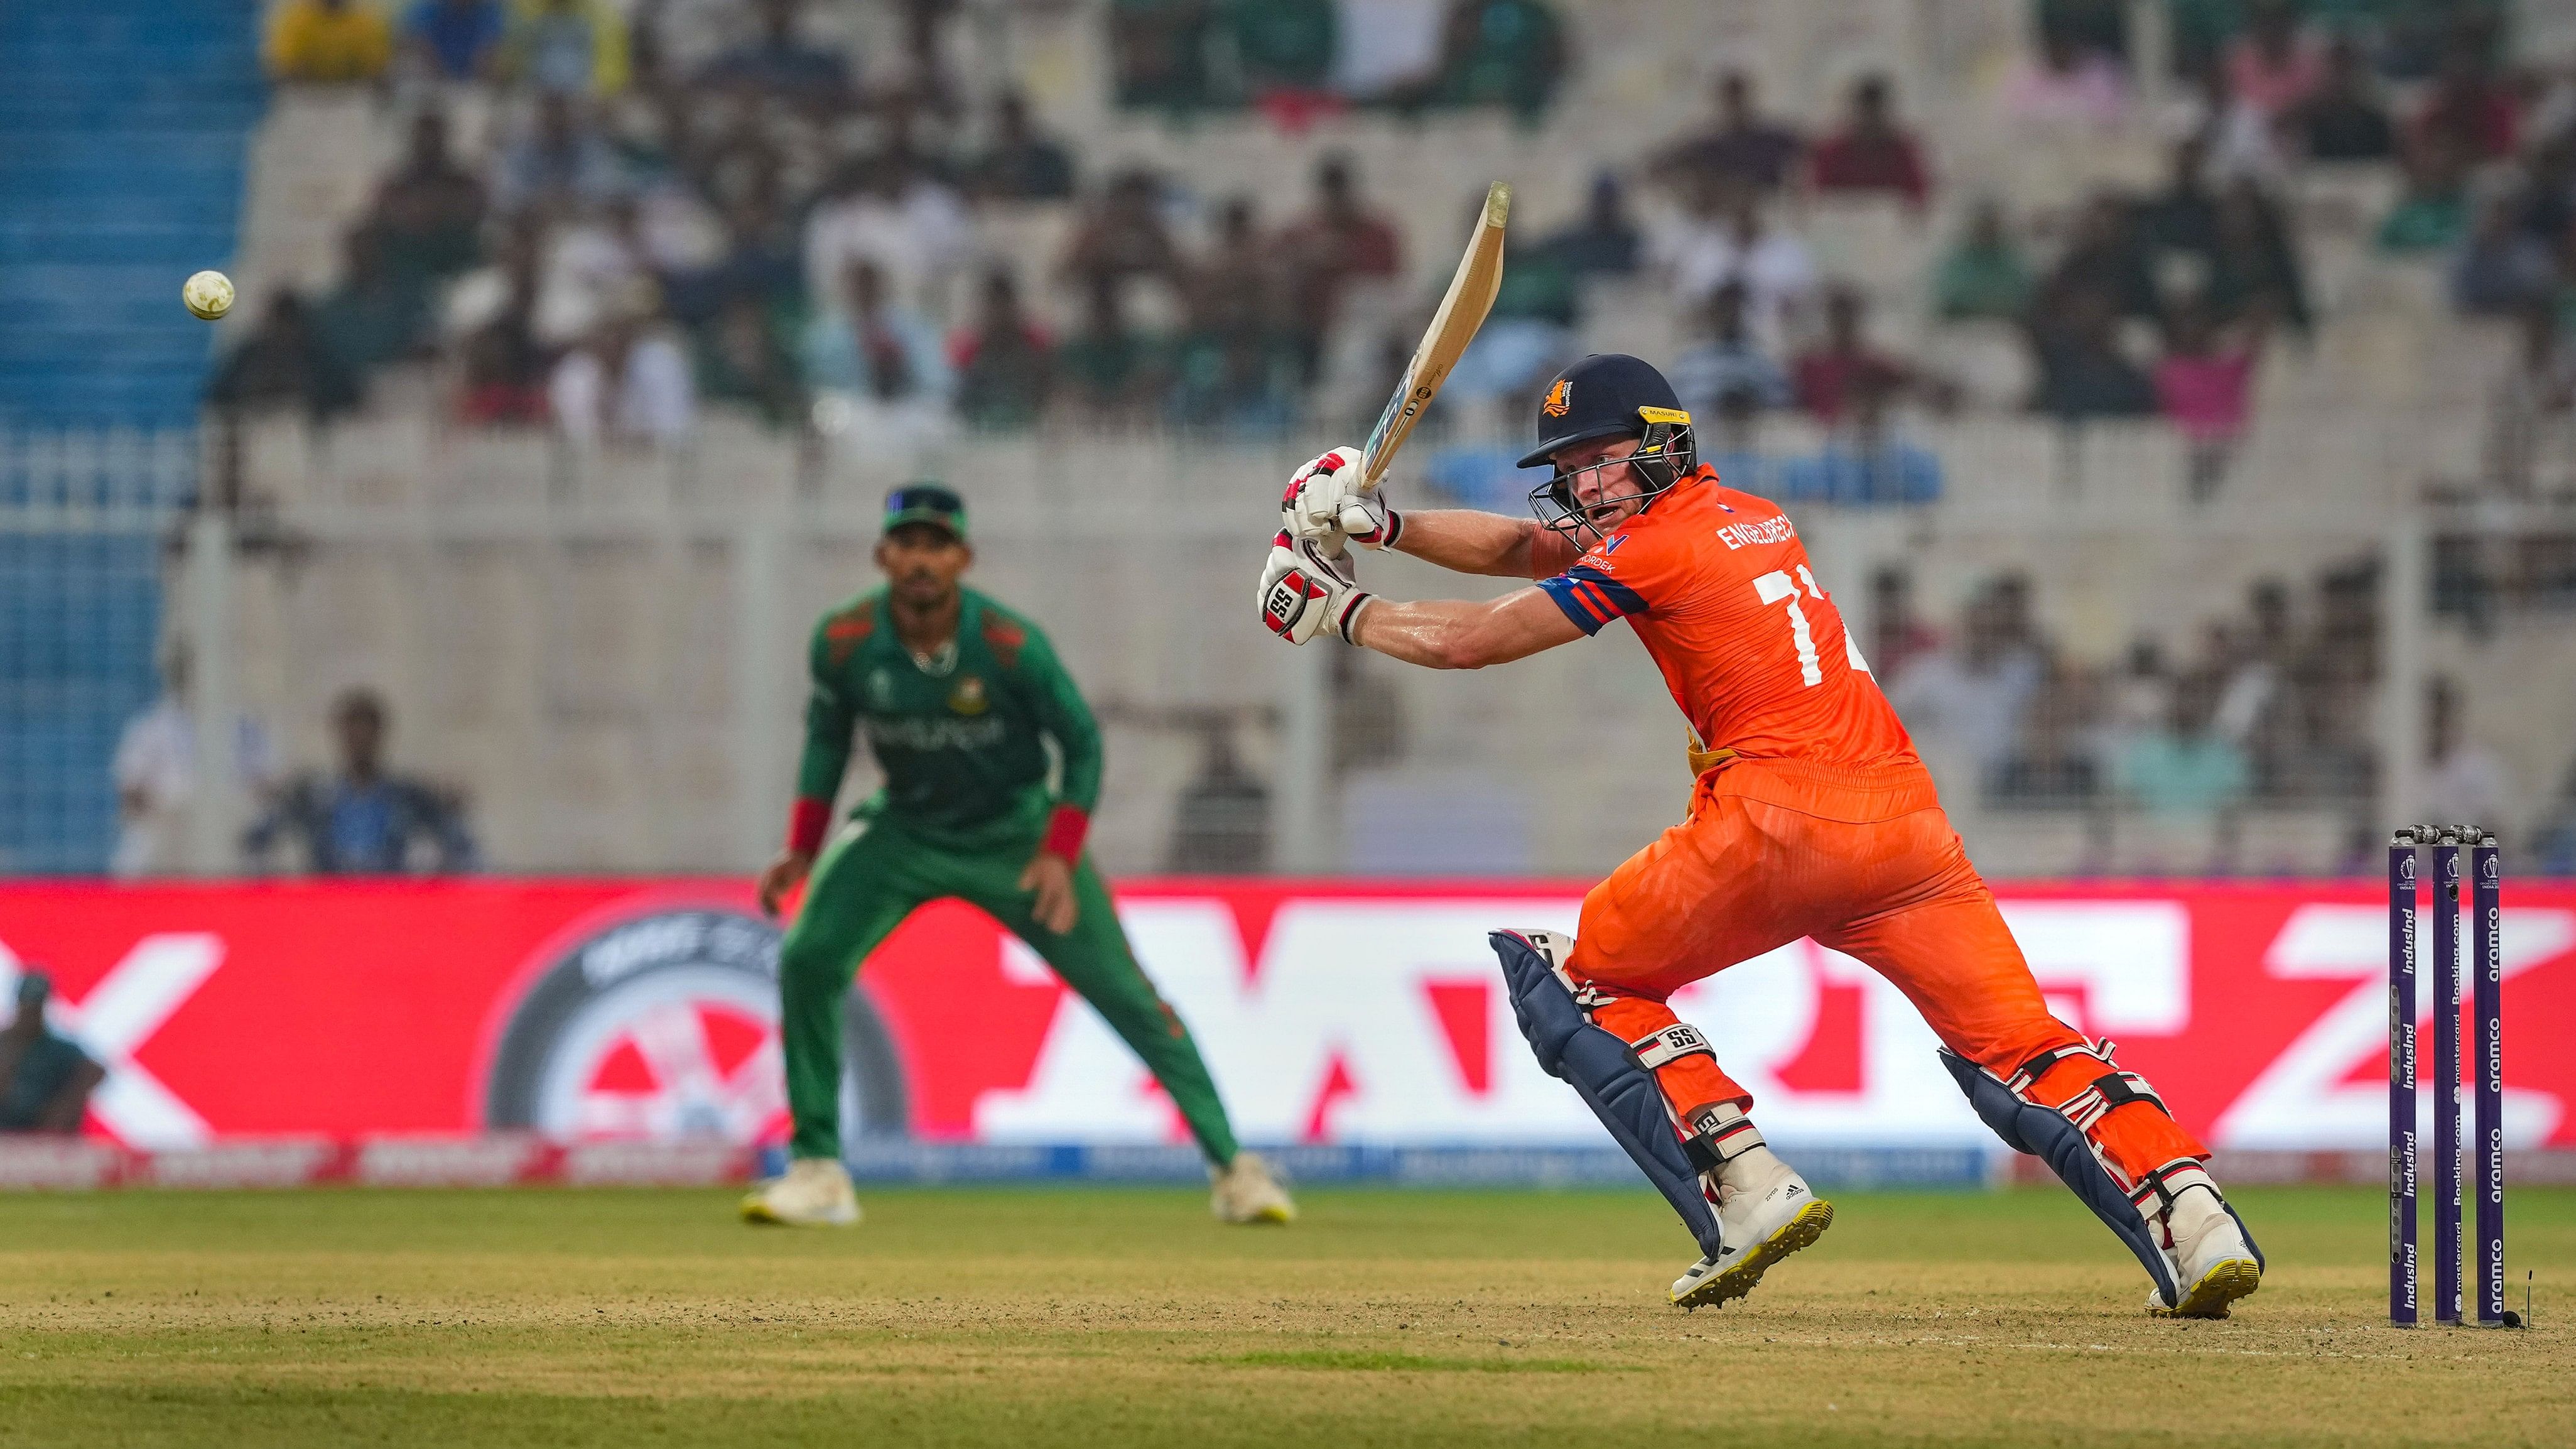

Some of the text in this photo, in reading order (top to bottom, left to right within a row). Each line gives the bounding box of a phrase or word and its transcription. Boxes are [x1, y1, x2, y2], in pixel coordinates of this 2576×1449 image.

[1270, 587, 1293, 619] SS
[2402, 908, 2413, 975] IndusInd
[2488, 907, 2499, 982] aramco
[1666, 1028, 1697, 1048] SS
[2403, 1023, 2414, 1089] IndusInd
[2489, 1018, 2500, 1093] aramco
[1785, 1188, 1804, 1200] adidas
[2403, 1131, 2415, 1197] IndusInd
[2491, 1128, 2501, 1203] aramco
[2404, 1243, 2415, 1310] IndusInd
[2491, 1239, 2503, 1314] aramco
